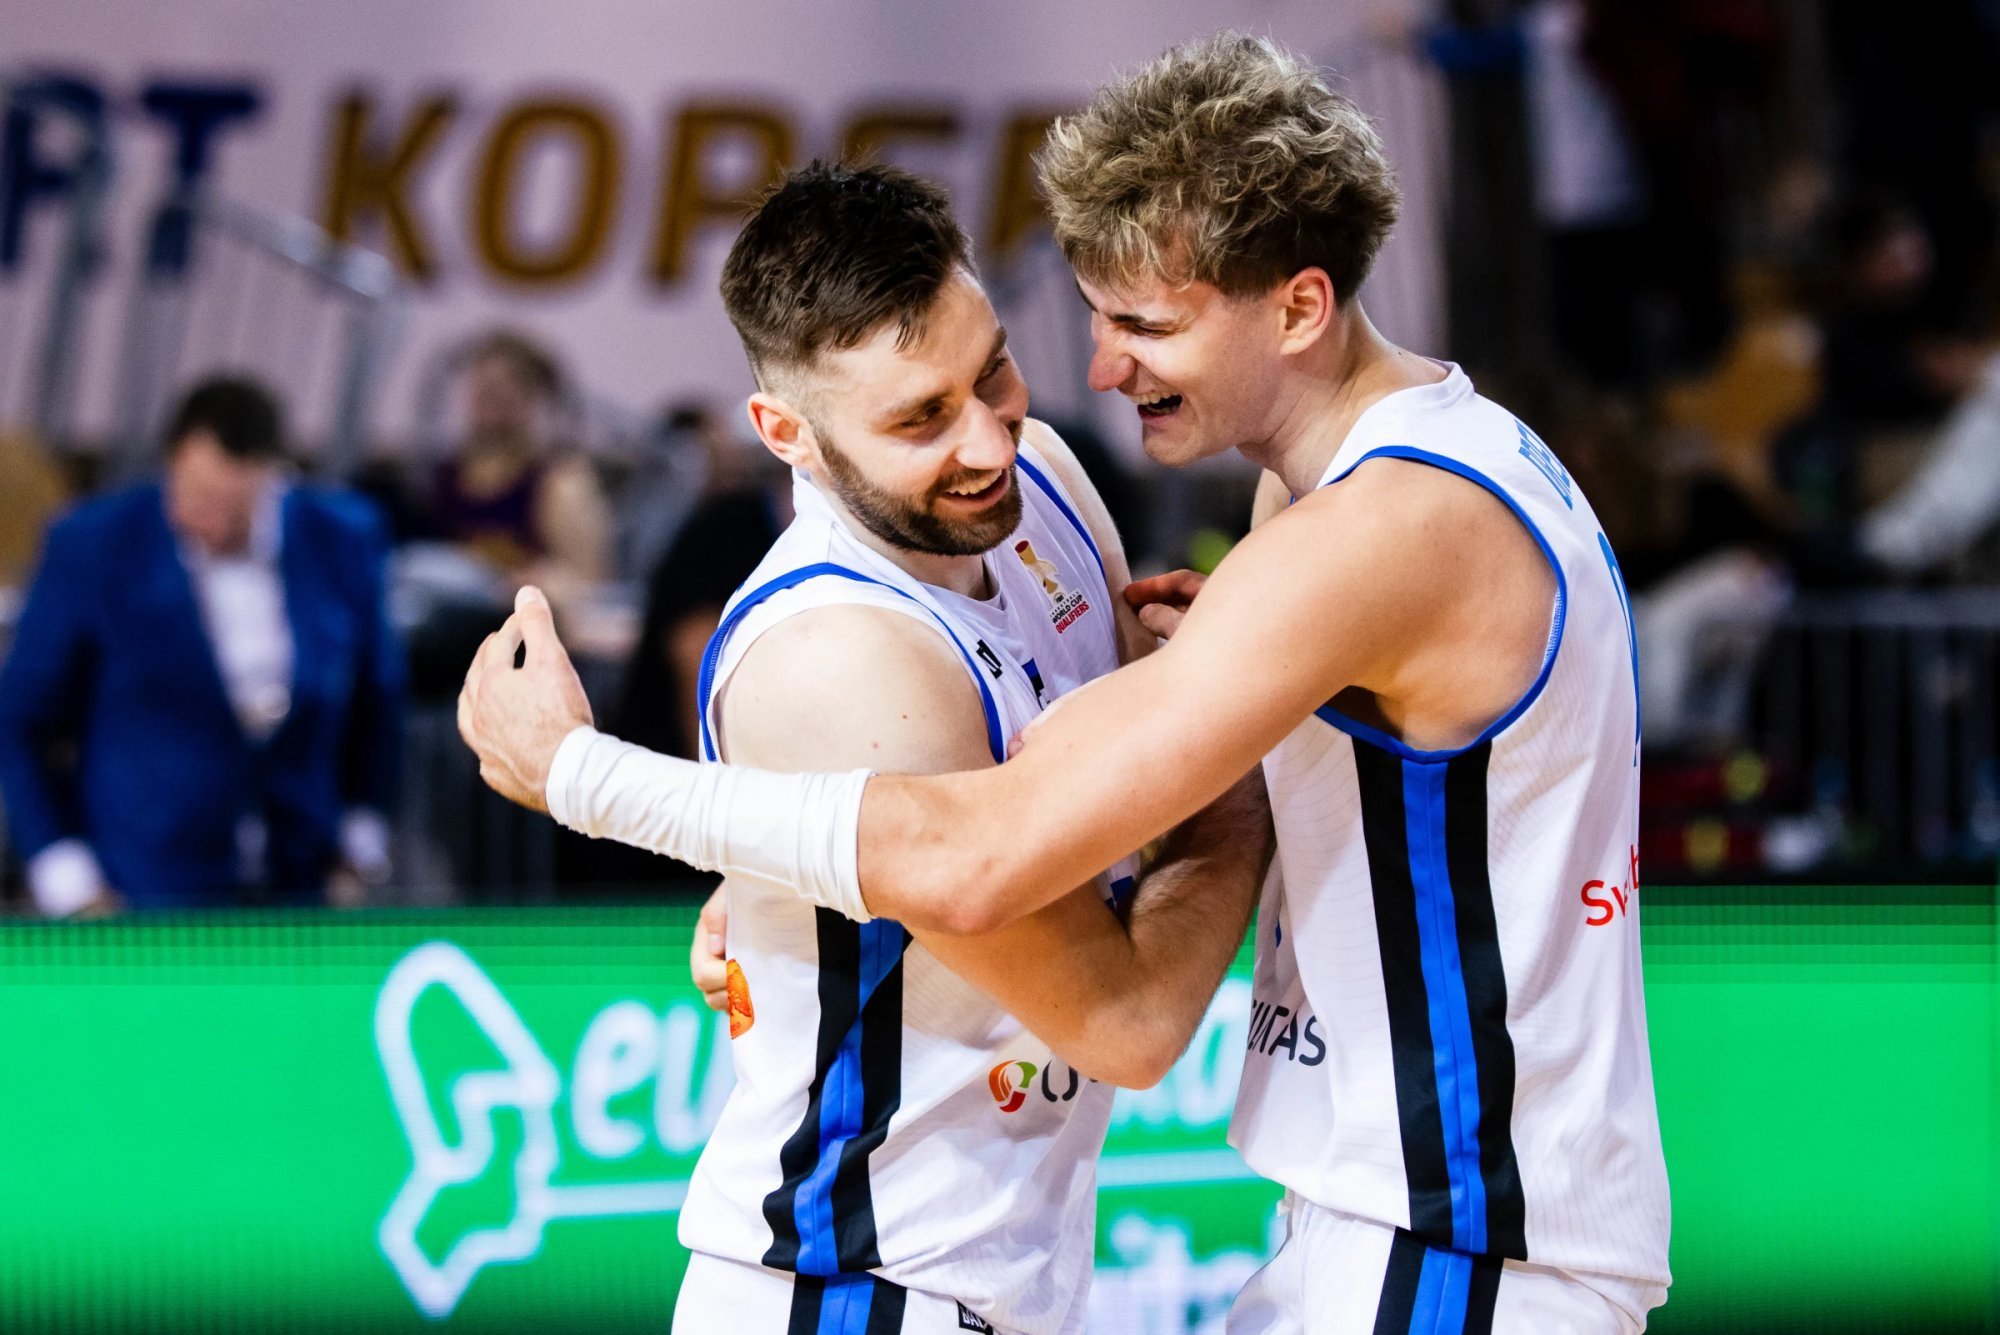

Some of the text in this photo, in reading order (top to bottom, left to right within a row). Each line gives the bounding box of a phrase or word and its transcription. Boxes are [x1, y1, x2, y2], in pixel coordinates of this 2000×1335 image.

[1052, 594, 1082, 624] WORLD CUP
[1055, 601, 1089, 634] QUALIFIERS
